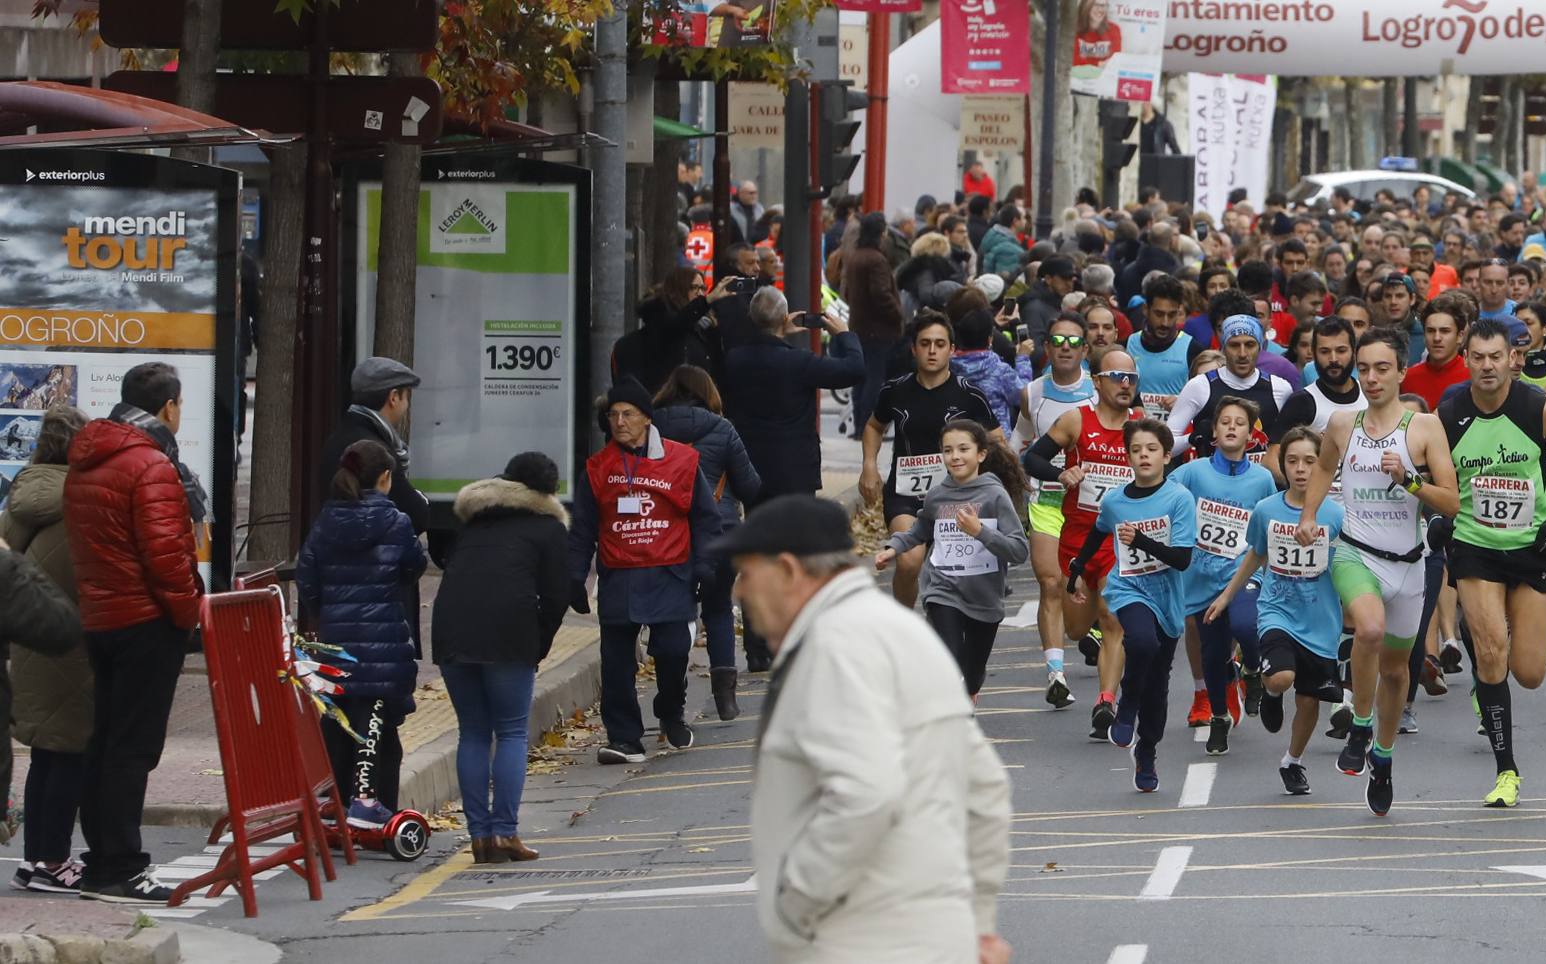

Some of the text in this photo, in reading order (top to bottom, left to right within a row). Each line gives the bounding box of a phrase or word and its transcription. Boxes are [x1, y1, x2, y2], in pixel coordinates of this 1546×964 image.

[1134, 7, 1160, 18] eres
[1168, 0, 1334, 22] ntamiento
[748, 105, 785, 116] CALL
[974, 113, 1010, 122] PASEO
[39, 169, 105, 181] exteriorplus
[447, 170, 496, 179] exteriorplus
[84, 211, 186, 236] mendi
[438, 198, 498, 233] LEROY MERLIN
[62, 227, 188, 270] tour
[122, 271, 157, 283] Mendi
[160, 272, 184, 283] Film
[0, 313, 146, 345] OGROÑO
[1087, 440, 1127, 454] AÑAR
[1356, 435, 1397, 449] TEJADA
[899, 455, 942, 468] CARRERA
[1460, 455, 1493, 475] Campo
[1089, 464, 1133, 479] ARRERA
[910, 475, 933, 492] 27
[1474, 477, 1530, 491] CARRERA
[1200, 500, 1249, 522] CARRERA
[1481, 499, 1523, 520] 187
[612, 518, 670, 533] Cáritas
[1273, 522, 1325, 538] CARA
[637, 537, 654, 546] Rioja
[1200, 523, 1239, 548] 628
[945, 543, 975, 559] 780
[1277, 545, 1317, 568] 311
[368, 712, 383, 740] lot
[1487, 704, 1506, 751] kalenji
[358, 739, 376, 757] of
